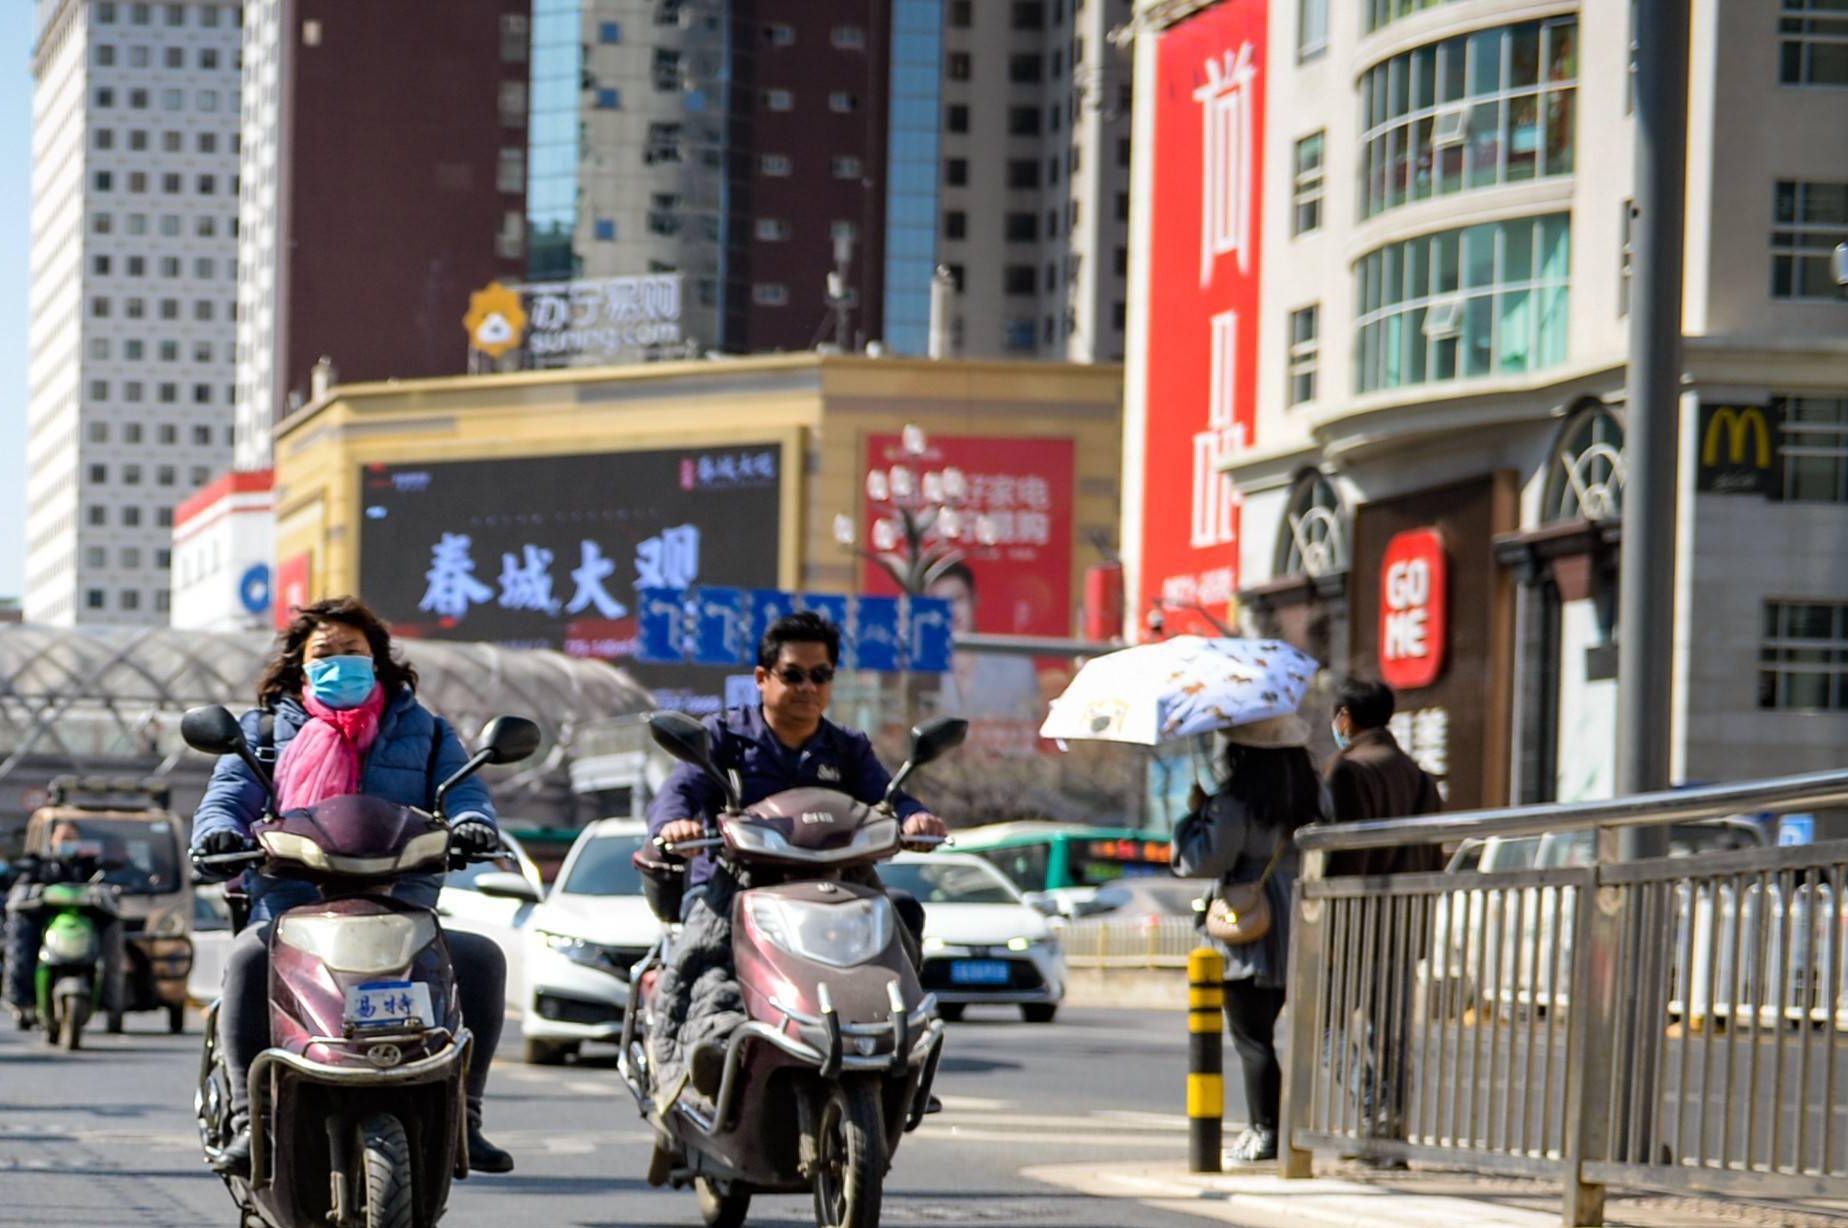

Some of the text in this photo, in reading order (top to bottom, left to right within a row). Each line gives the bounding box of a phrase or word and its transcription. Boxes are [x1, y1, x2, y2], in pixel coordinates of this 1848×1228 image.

[531, 275, 682, 330] 苏宁易购
[418, 523, 701, 618] 春城大观
[1386, 556, 1429, 611] GO
[1383, 607, 1429, 661] ME
